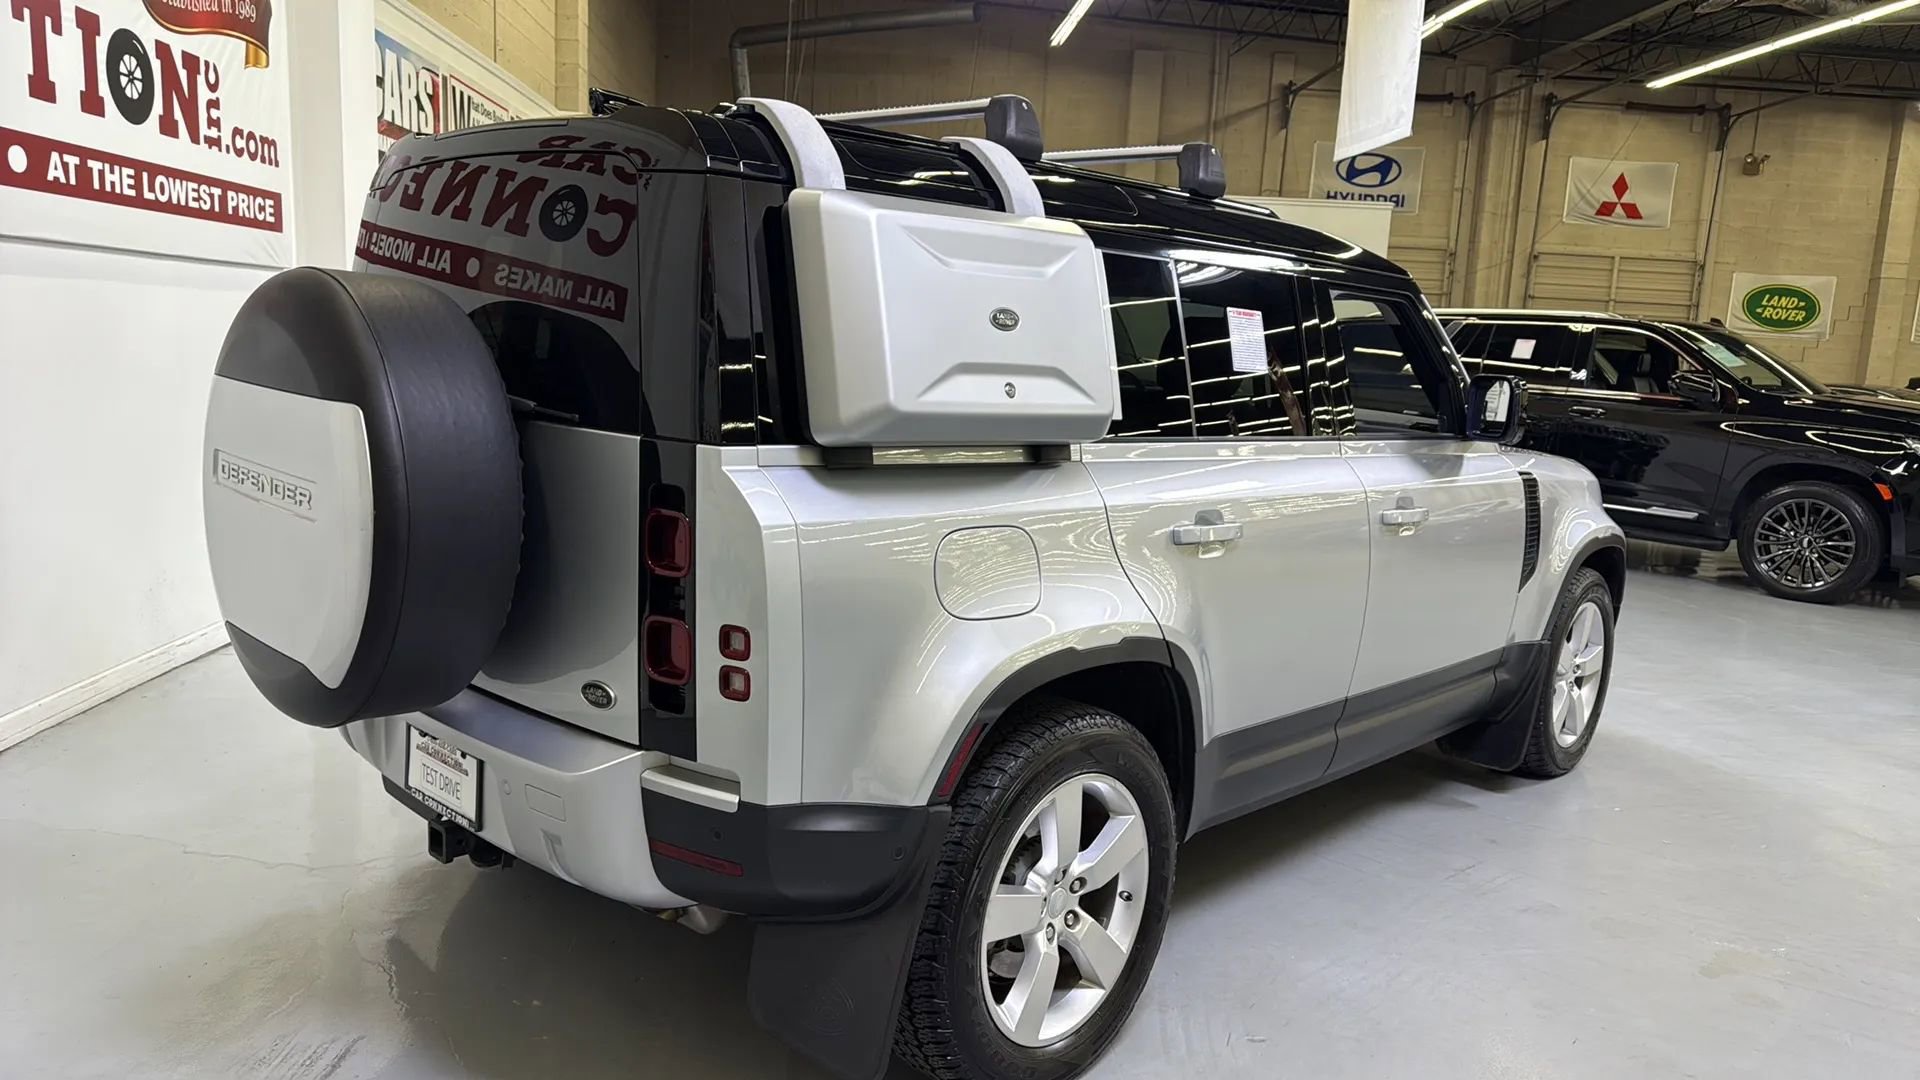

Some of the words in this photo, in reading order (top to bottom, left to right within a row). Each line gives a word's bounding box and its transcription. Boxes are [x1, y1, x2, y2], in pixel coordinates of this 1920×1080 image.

[235, 0, 257, 23] 1989
[203, 60, 223, 153] Inc
[225, 126, 280, 168] .com
[47, 150, 80, 186] AT
[87, 159, 137, 197] THE
[142, 171, 223, 213] LOWEST
[227, 192, 276, 223] PRICE
[1761, 294, 1799, 309] LAND
[1761, 306, 1806, 322] ROVER
[220, 458, 313, 511] DEFENDER
[422, 762, 439, 788] TEST
[440, 773, 461, 801] DRIVE
